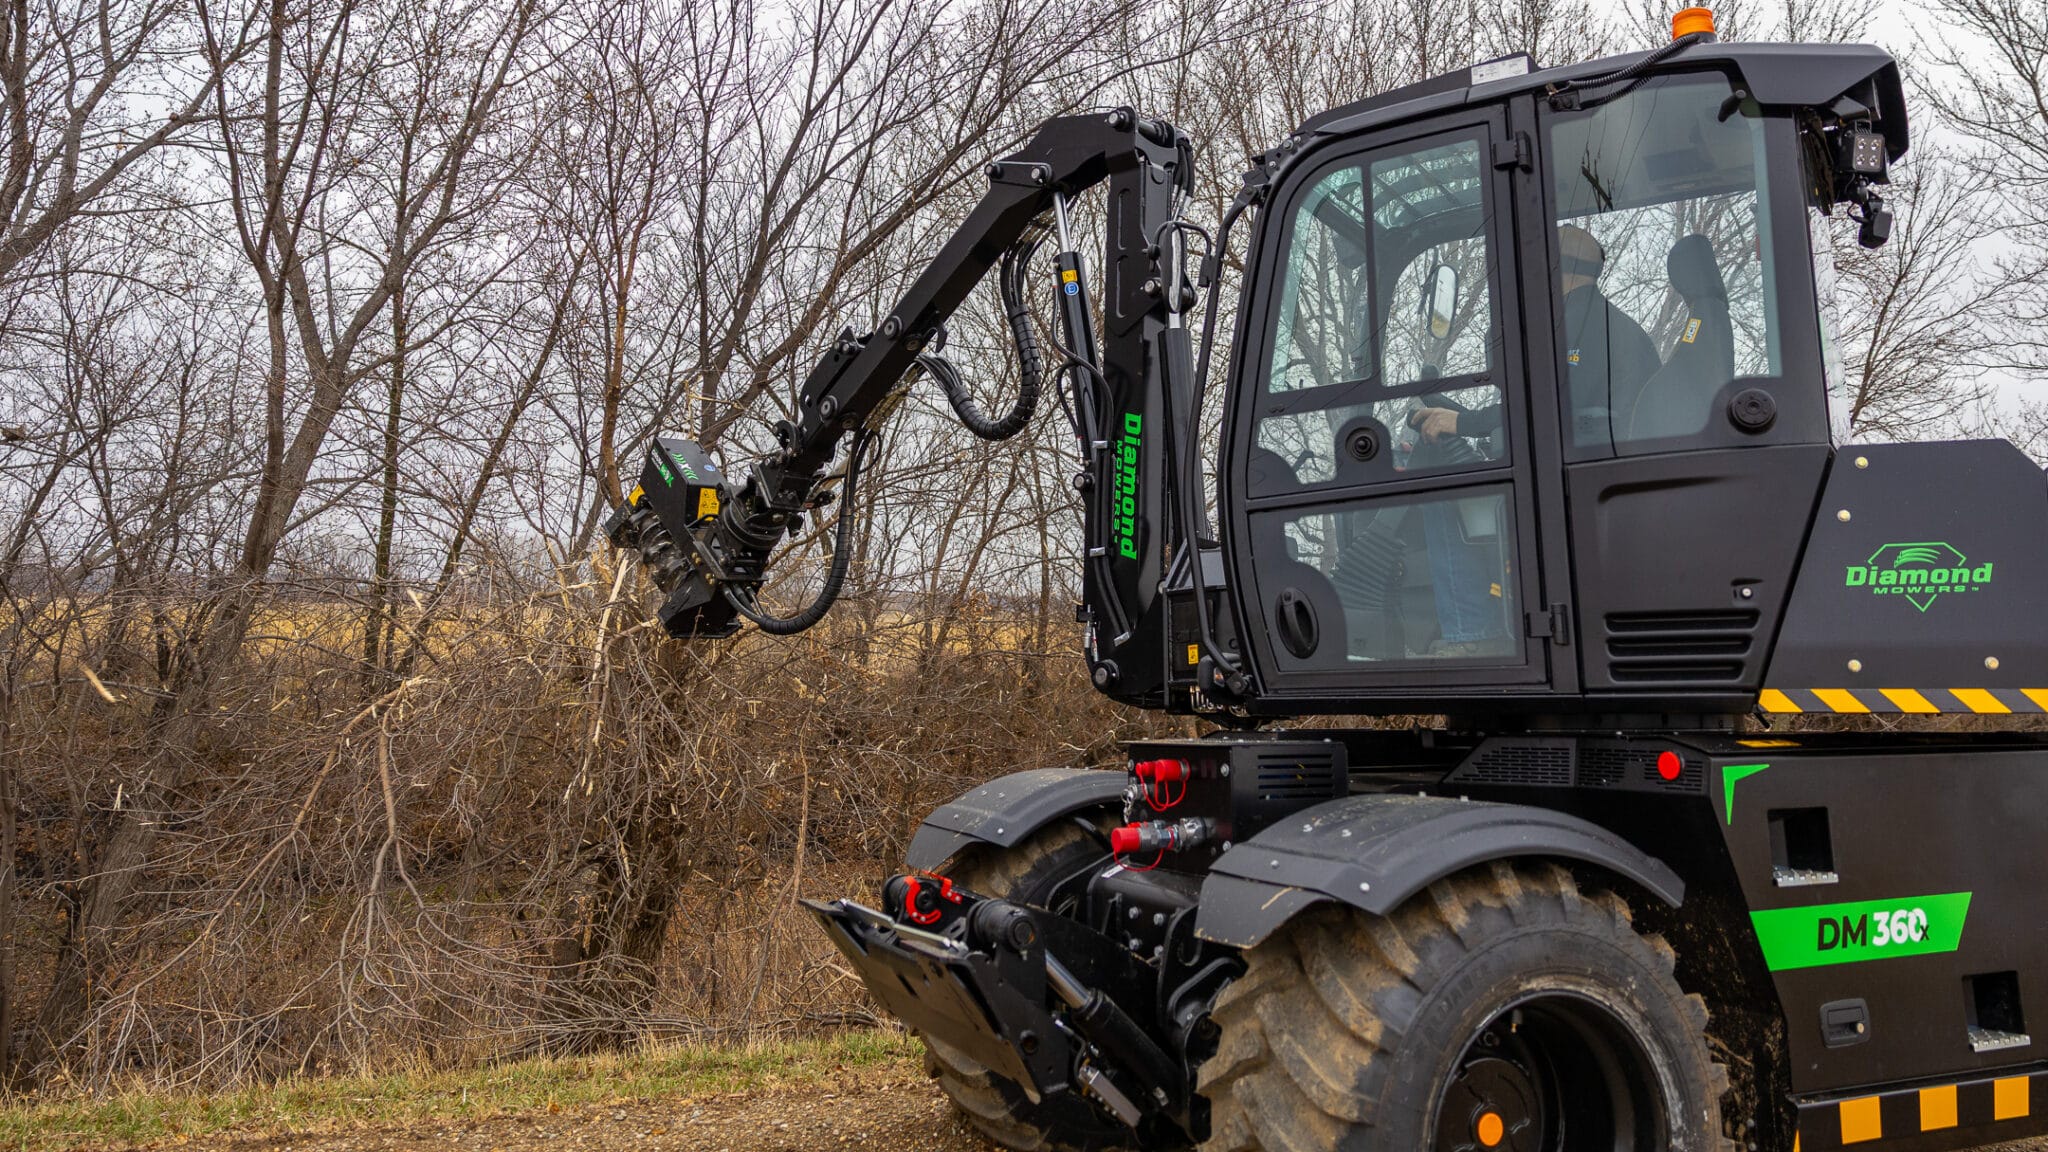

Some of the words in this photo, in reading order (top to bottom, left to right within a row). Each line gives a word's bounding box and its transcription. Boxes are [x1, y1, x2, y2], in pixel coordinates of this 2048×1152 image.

[1113, 440, 1123, 531] MOWERS
[1120, 412, 1143, 560] Diamond
[1845, 562, 1993, 586] Diamond
[1873, 585, 1966, 594] MOWERS
